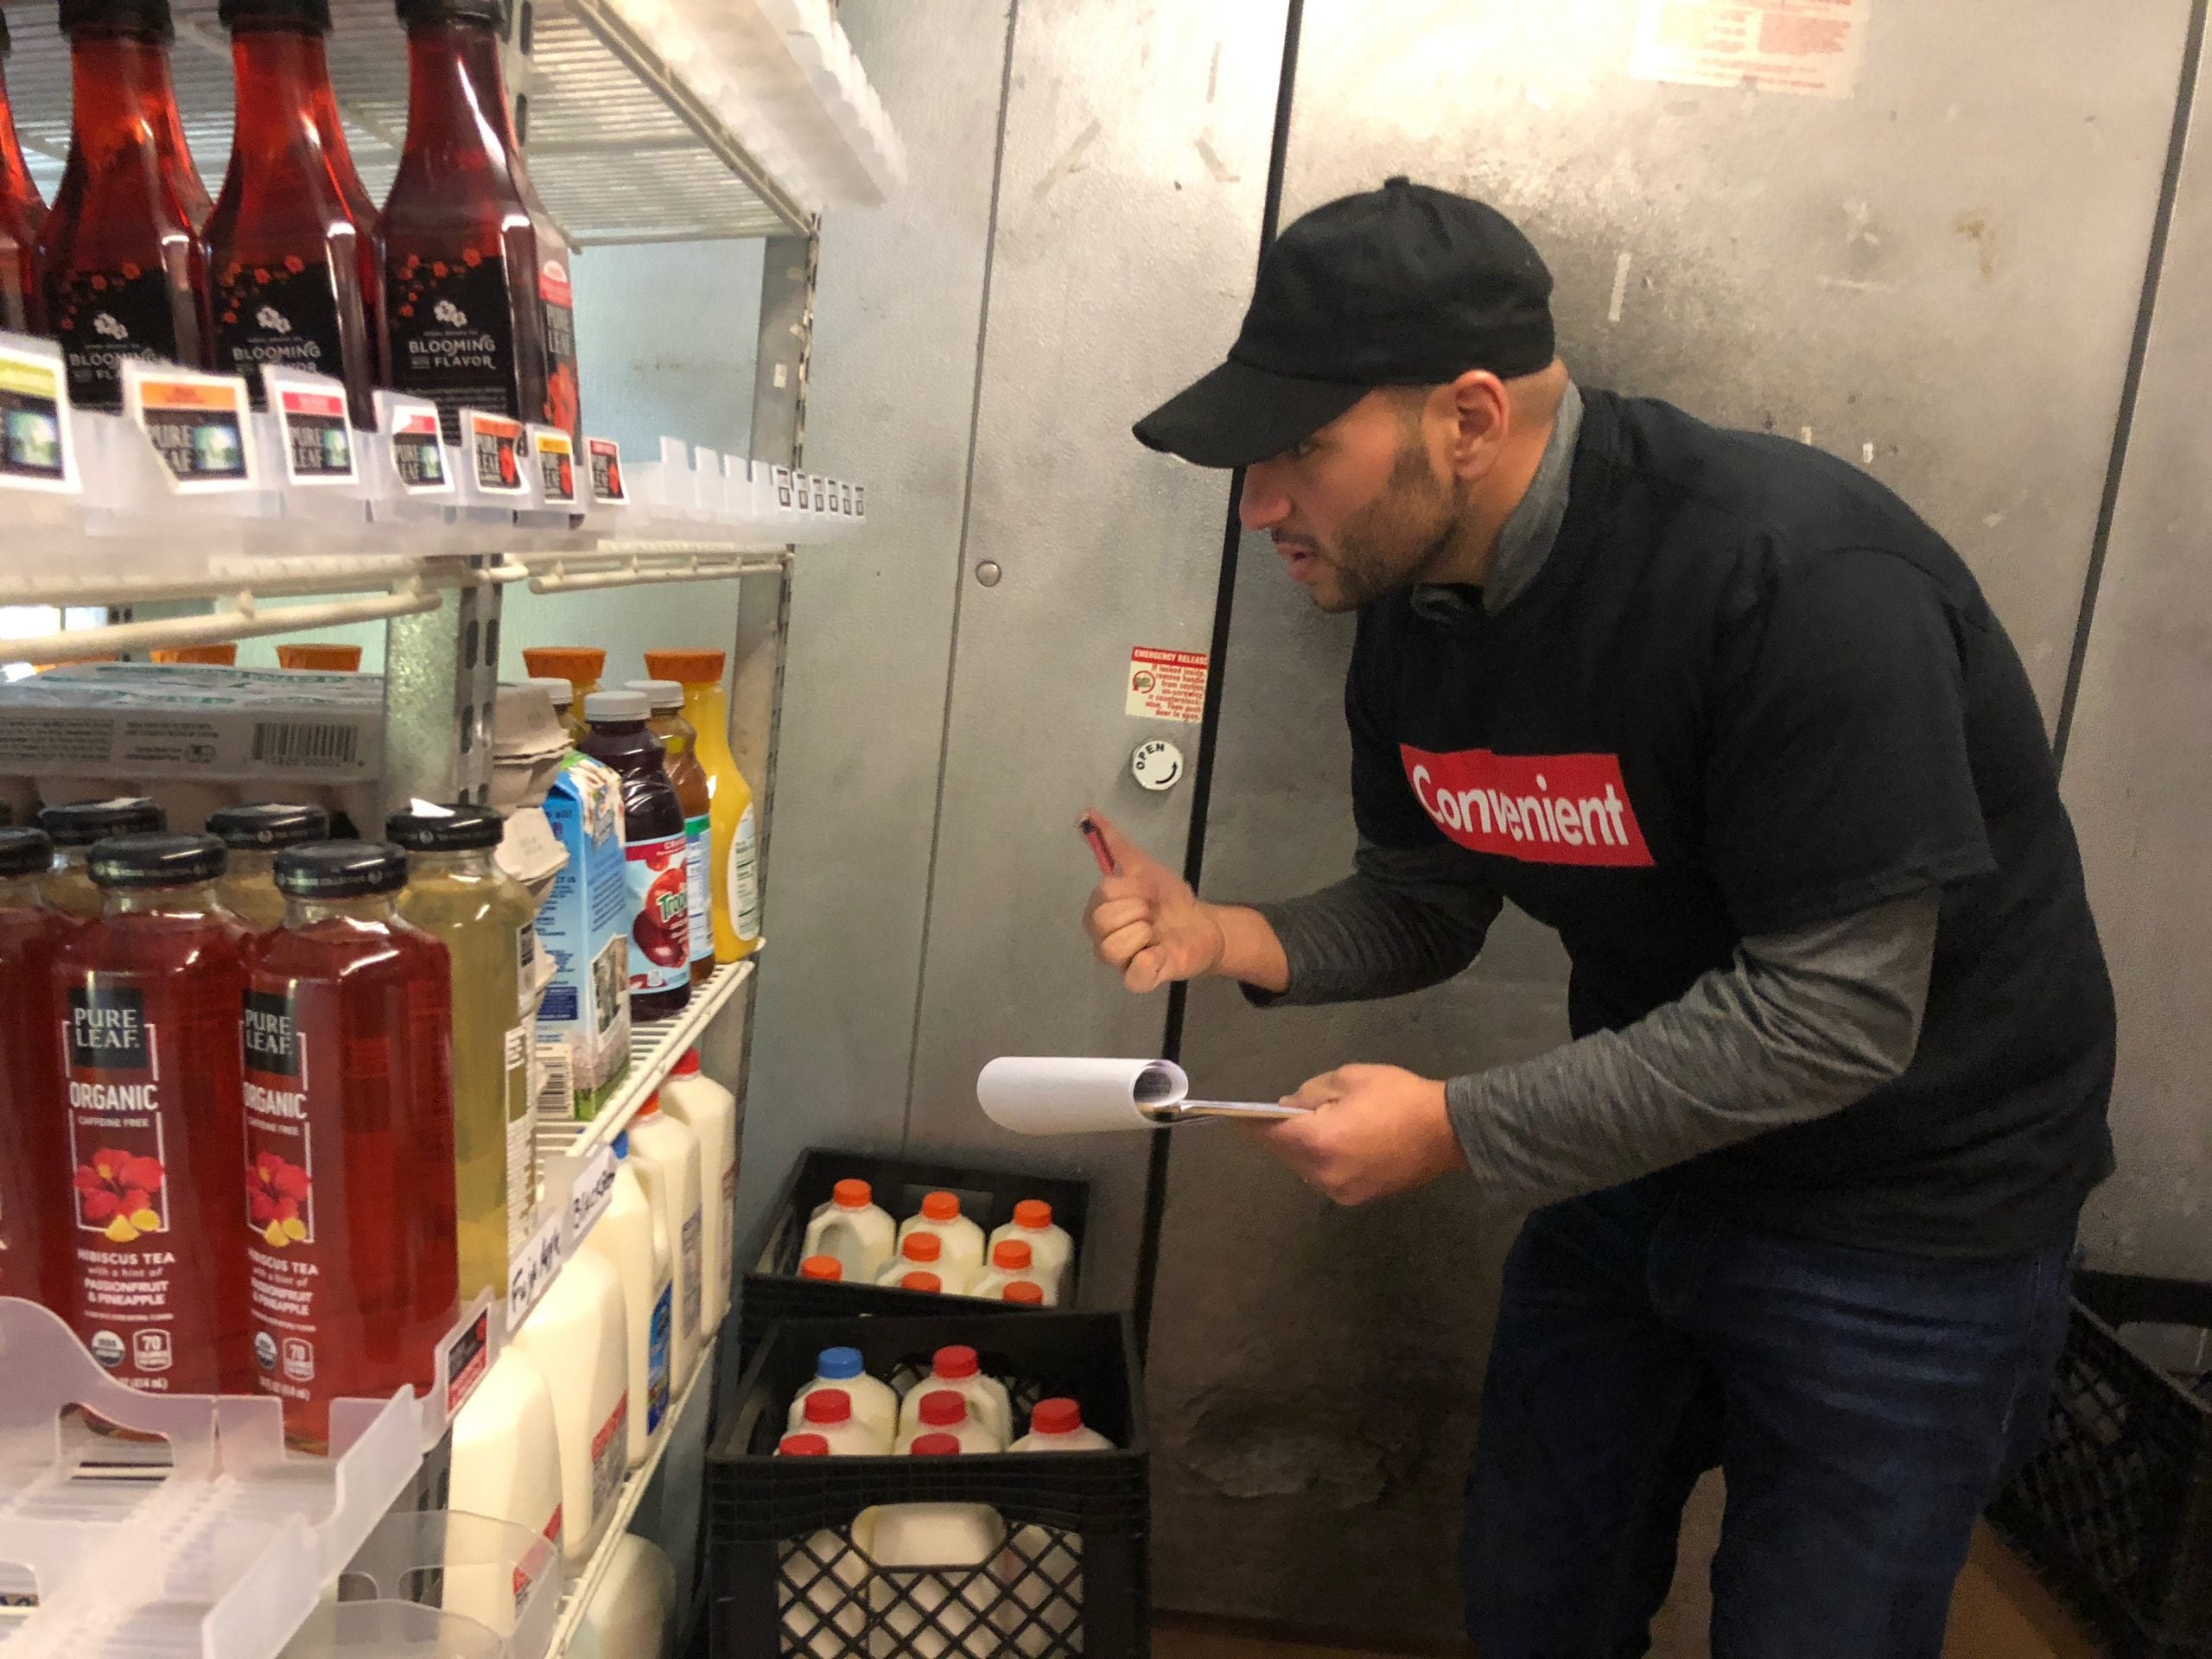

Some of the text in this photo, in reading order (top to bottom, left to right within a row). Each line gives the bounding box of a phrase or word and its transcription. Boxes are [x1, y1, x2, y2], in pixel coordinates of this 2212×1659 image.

[232, 341, 321, 364] BLOOMING
[409, 334, 496, 356] BLOOMING
[435, 355, 496, 370] FLAVOR
[1134, 649, 1177, 662] EMERGENCY
[1136, 743, 1166, 771] OPEN
[1413, 764, 1630, 847] Convenient
[74, 1007, 138, 1028] PURE
[245, 1009, 292, 1035] PURE
[75, 1028, 141, 1049] LEAF
[245, 1031, 293, 1055] LEAF
[69, 1082, 160, 1111] ORGANIC
[242, 1082, 308, 1119] ORGANIC
[77, 1249, 176, 1265] HIBISCUS TEA
[290, 1261, 320, 1276] TEA
[84, 1277, 170, 1293] PASSIONFRUIT
[97, 1293, 166, 1306] PINEAPPLE
[142, 1335, 162, 1351] 70
